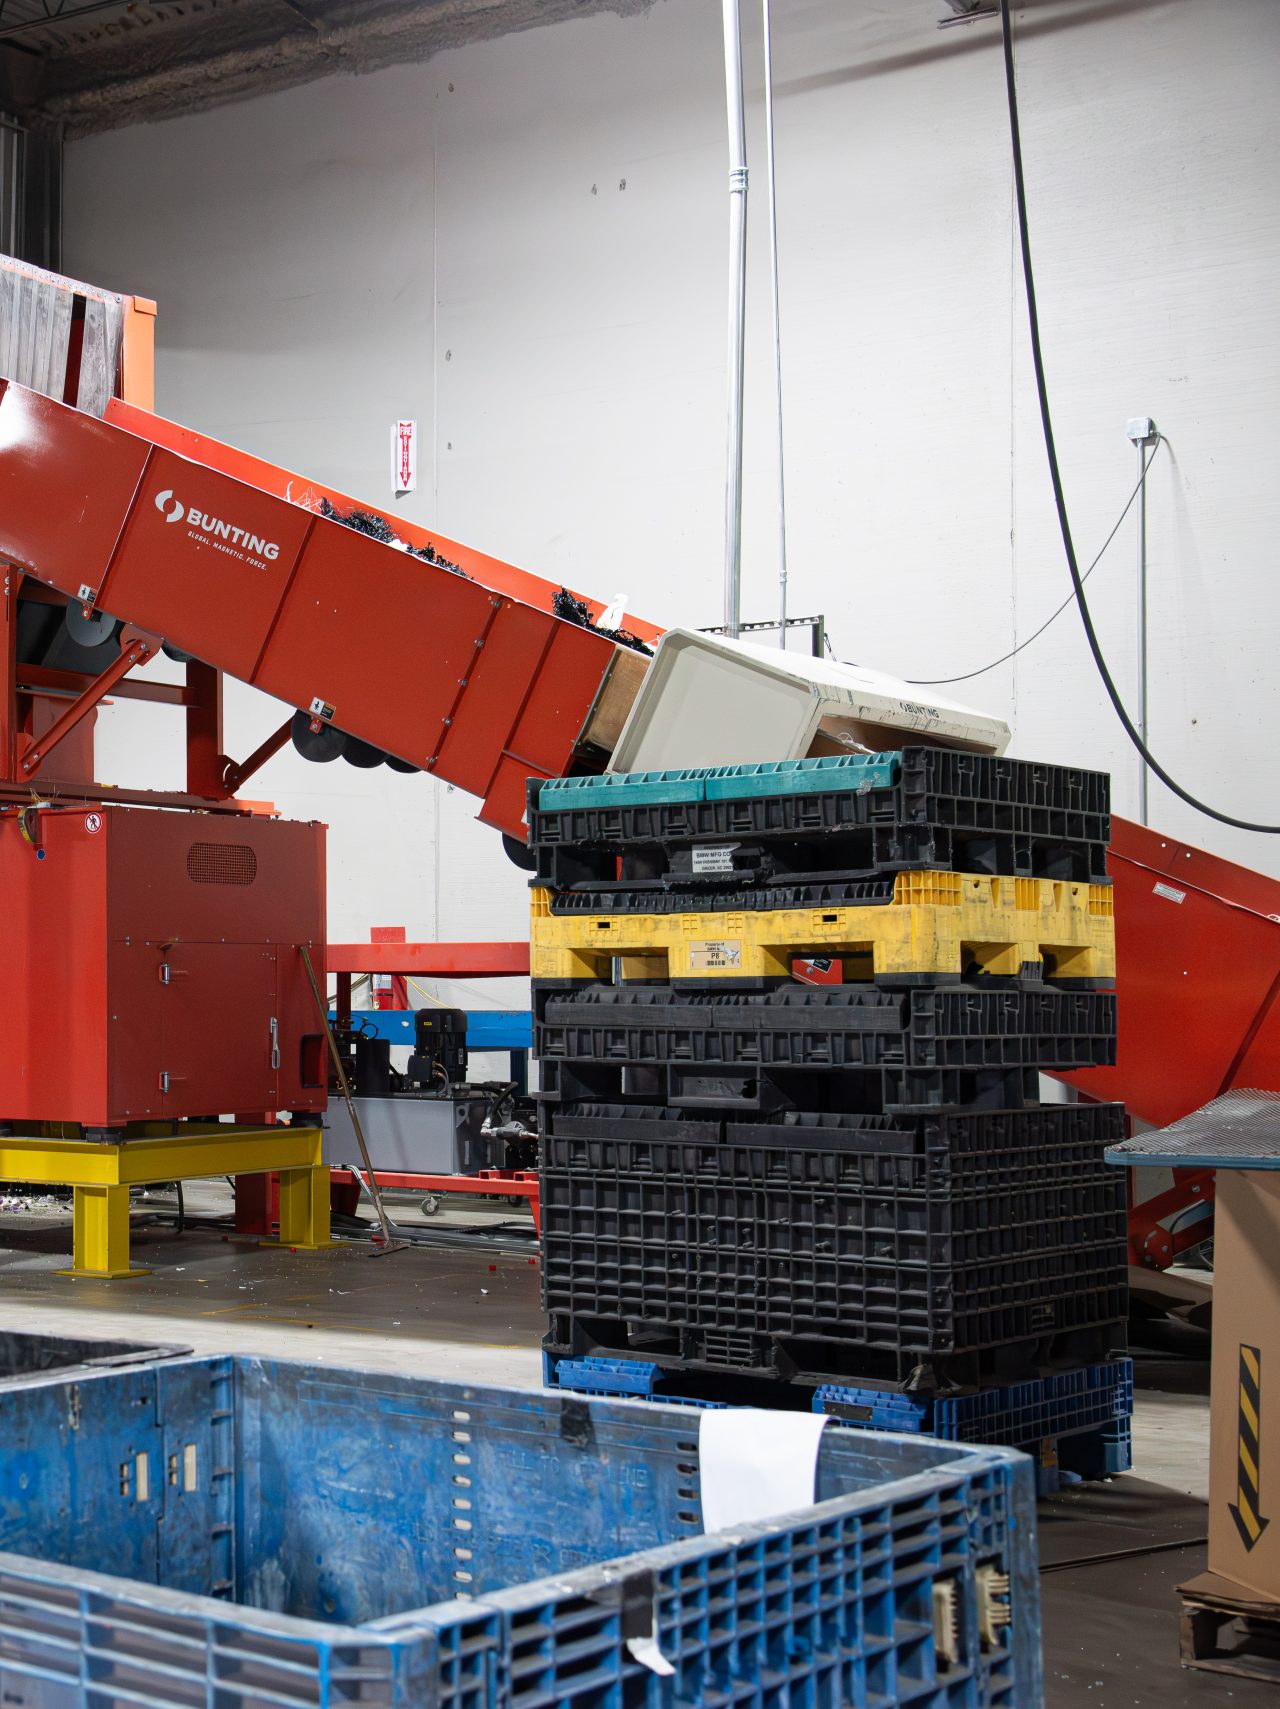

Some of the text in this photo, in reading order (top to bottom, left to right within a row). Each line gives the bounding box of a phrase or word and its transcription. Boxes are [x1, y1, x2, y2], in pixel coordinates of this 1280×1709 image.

[186, 507, 280, 560] BUNTING
[212, 542, 244, 561] MAGNETIC.
[245, 556, 267, 571] FORCE.
[907, 703, 939, 718] BUNTNG
